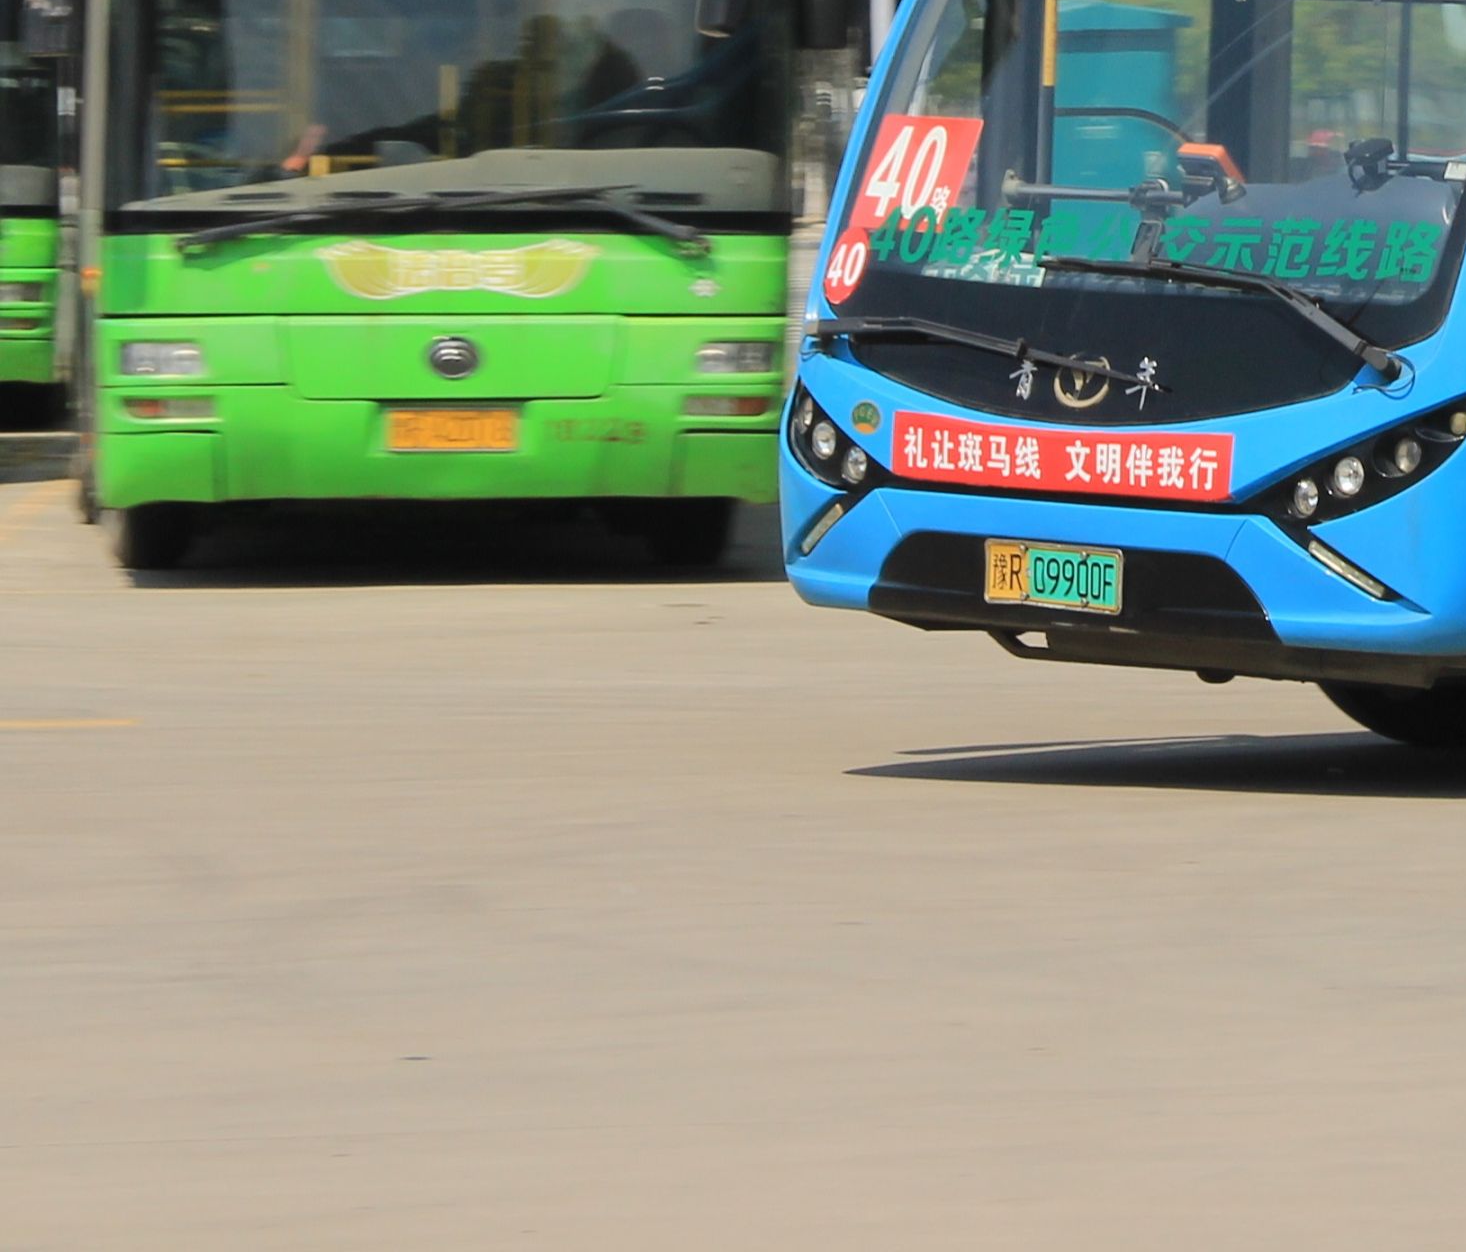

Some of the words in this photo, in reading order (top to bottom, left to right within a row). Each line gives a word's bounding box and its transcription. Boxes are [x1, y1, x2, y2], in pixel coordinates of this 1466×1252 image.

[865, 124, 951, 224] 40路
[825, 242, 866, 287] 40
[904, 426, 1041, 480] 礼让斑马线
[1065, 439, 1218, 491] 文明伴我行
